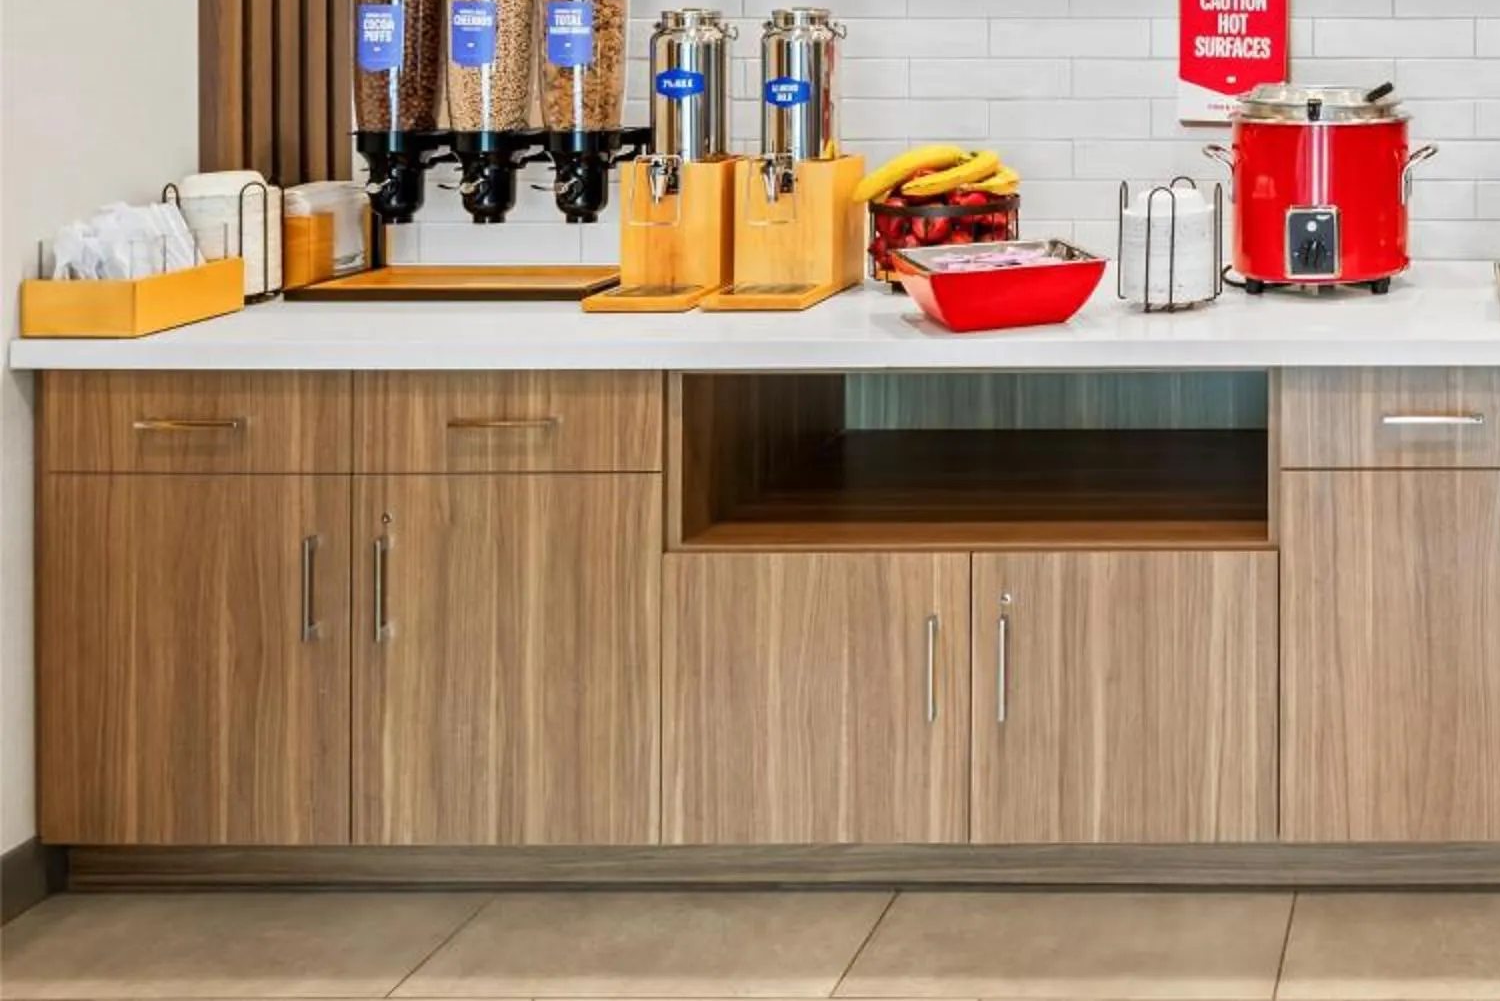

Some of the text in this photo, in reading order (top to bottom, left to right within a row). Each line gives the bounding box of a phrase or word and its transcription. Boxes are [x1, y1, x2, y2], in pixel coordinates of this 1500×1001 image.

[554, 14, 584, 27] TOTAL
[1217, 12, 1249, 35] HOT
[1194, 36, 1272, 59] SURFACES
